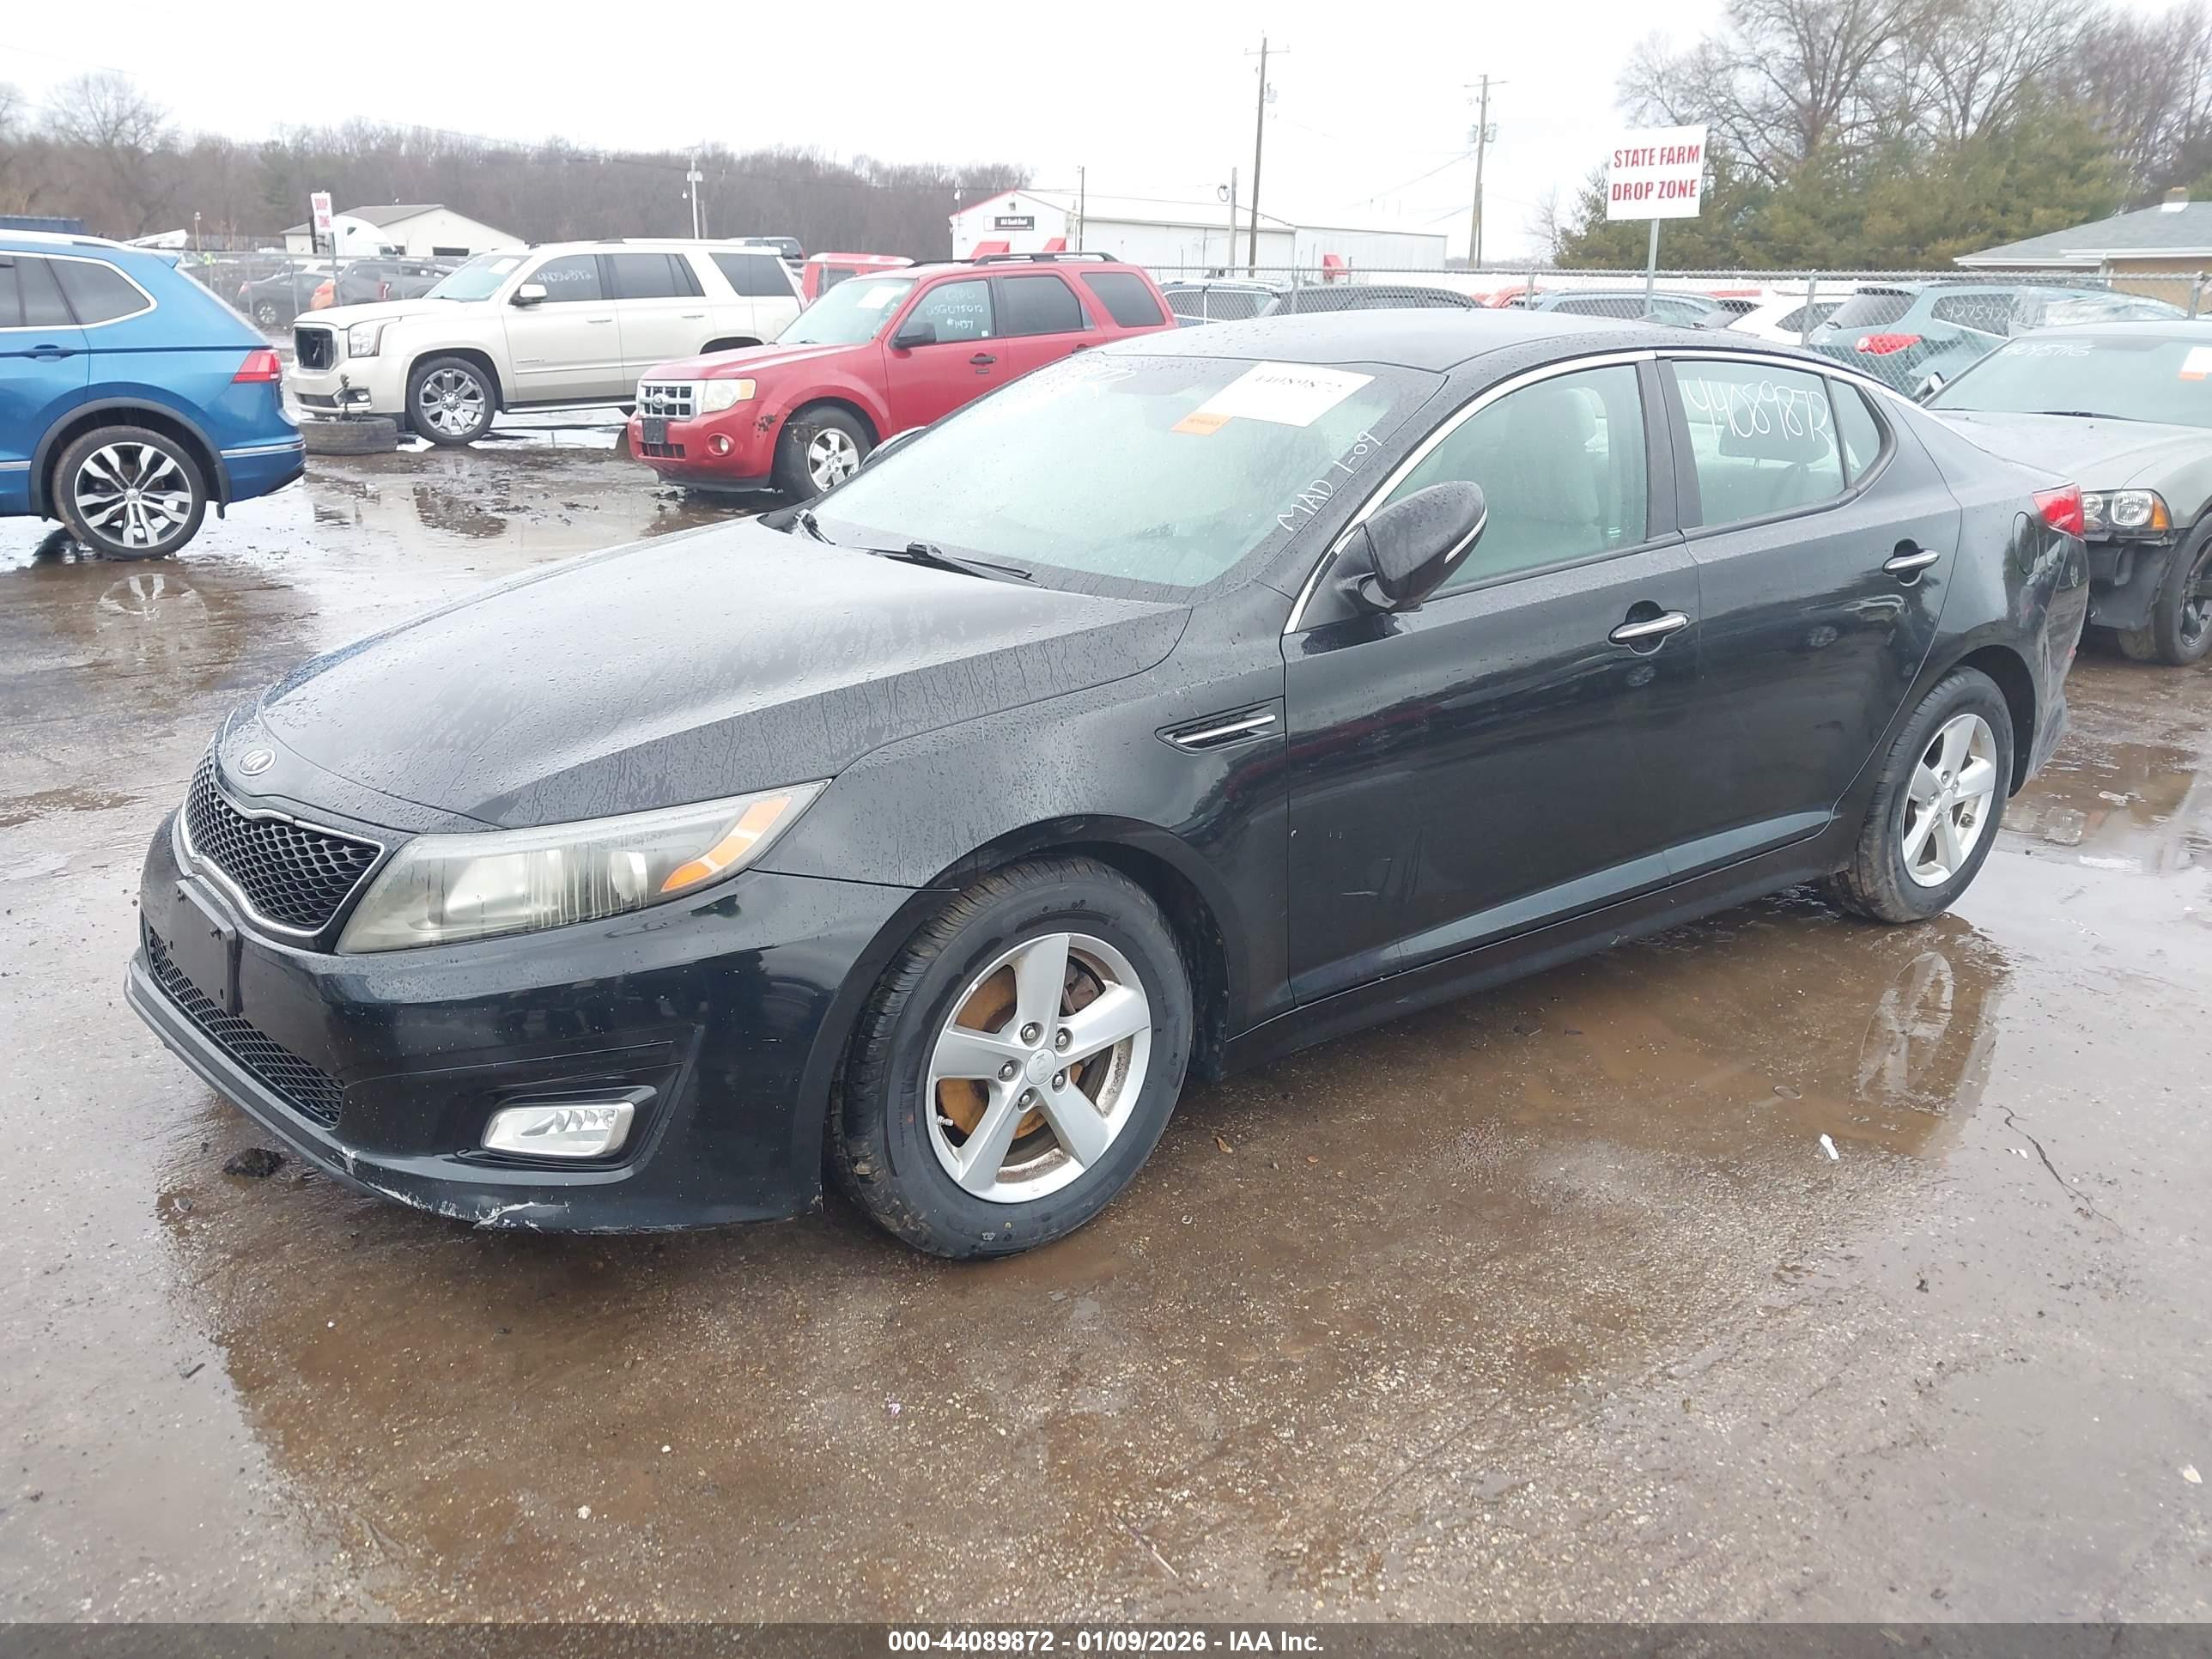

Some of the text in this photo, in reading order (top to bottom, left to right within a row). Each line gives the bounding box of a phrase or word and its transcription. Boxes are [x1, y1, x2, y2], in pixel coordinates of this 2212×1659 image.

[1614, 144, 1700, 168] STATE FARM
[1612, 179, 1698, 201] DROP ZONE
[1277, 431, 1382, 532] MAD 1-09
